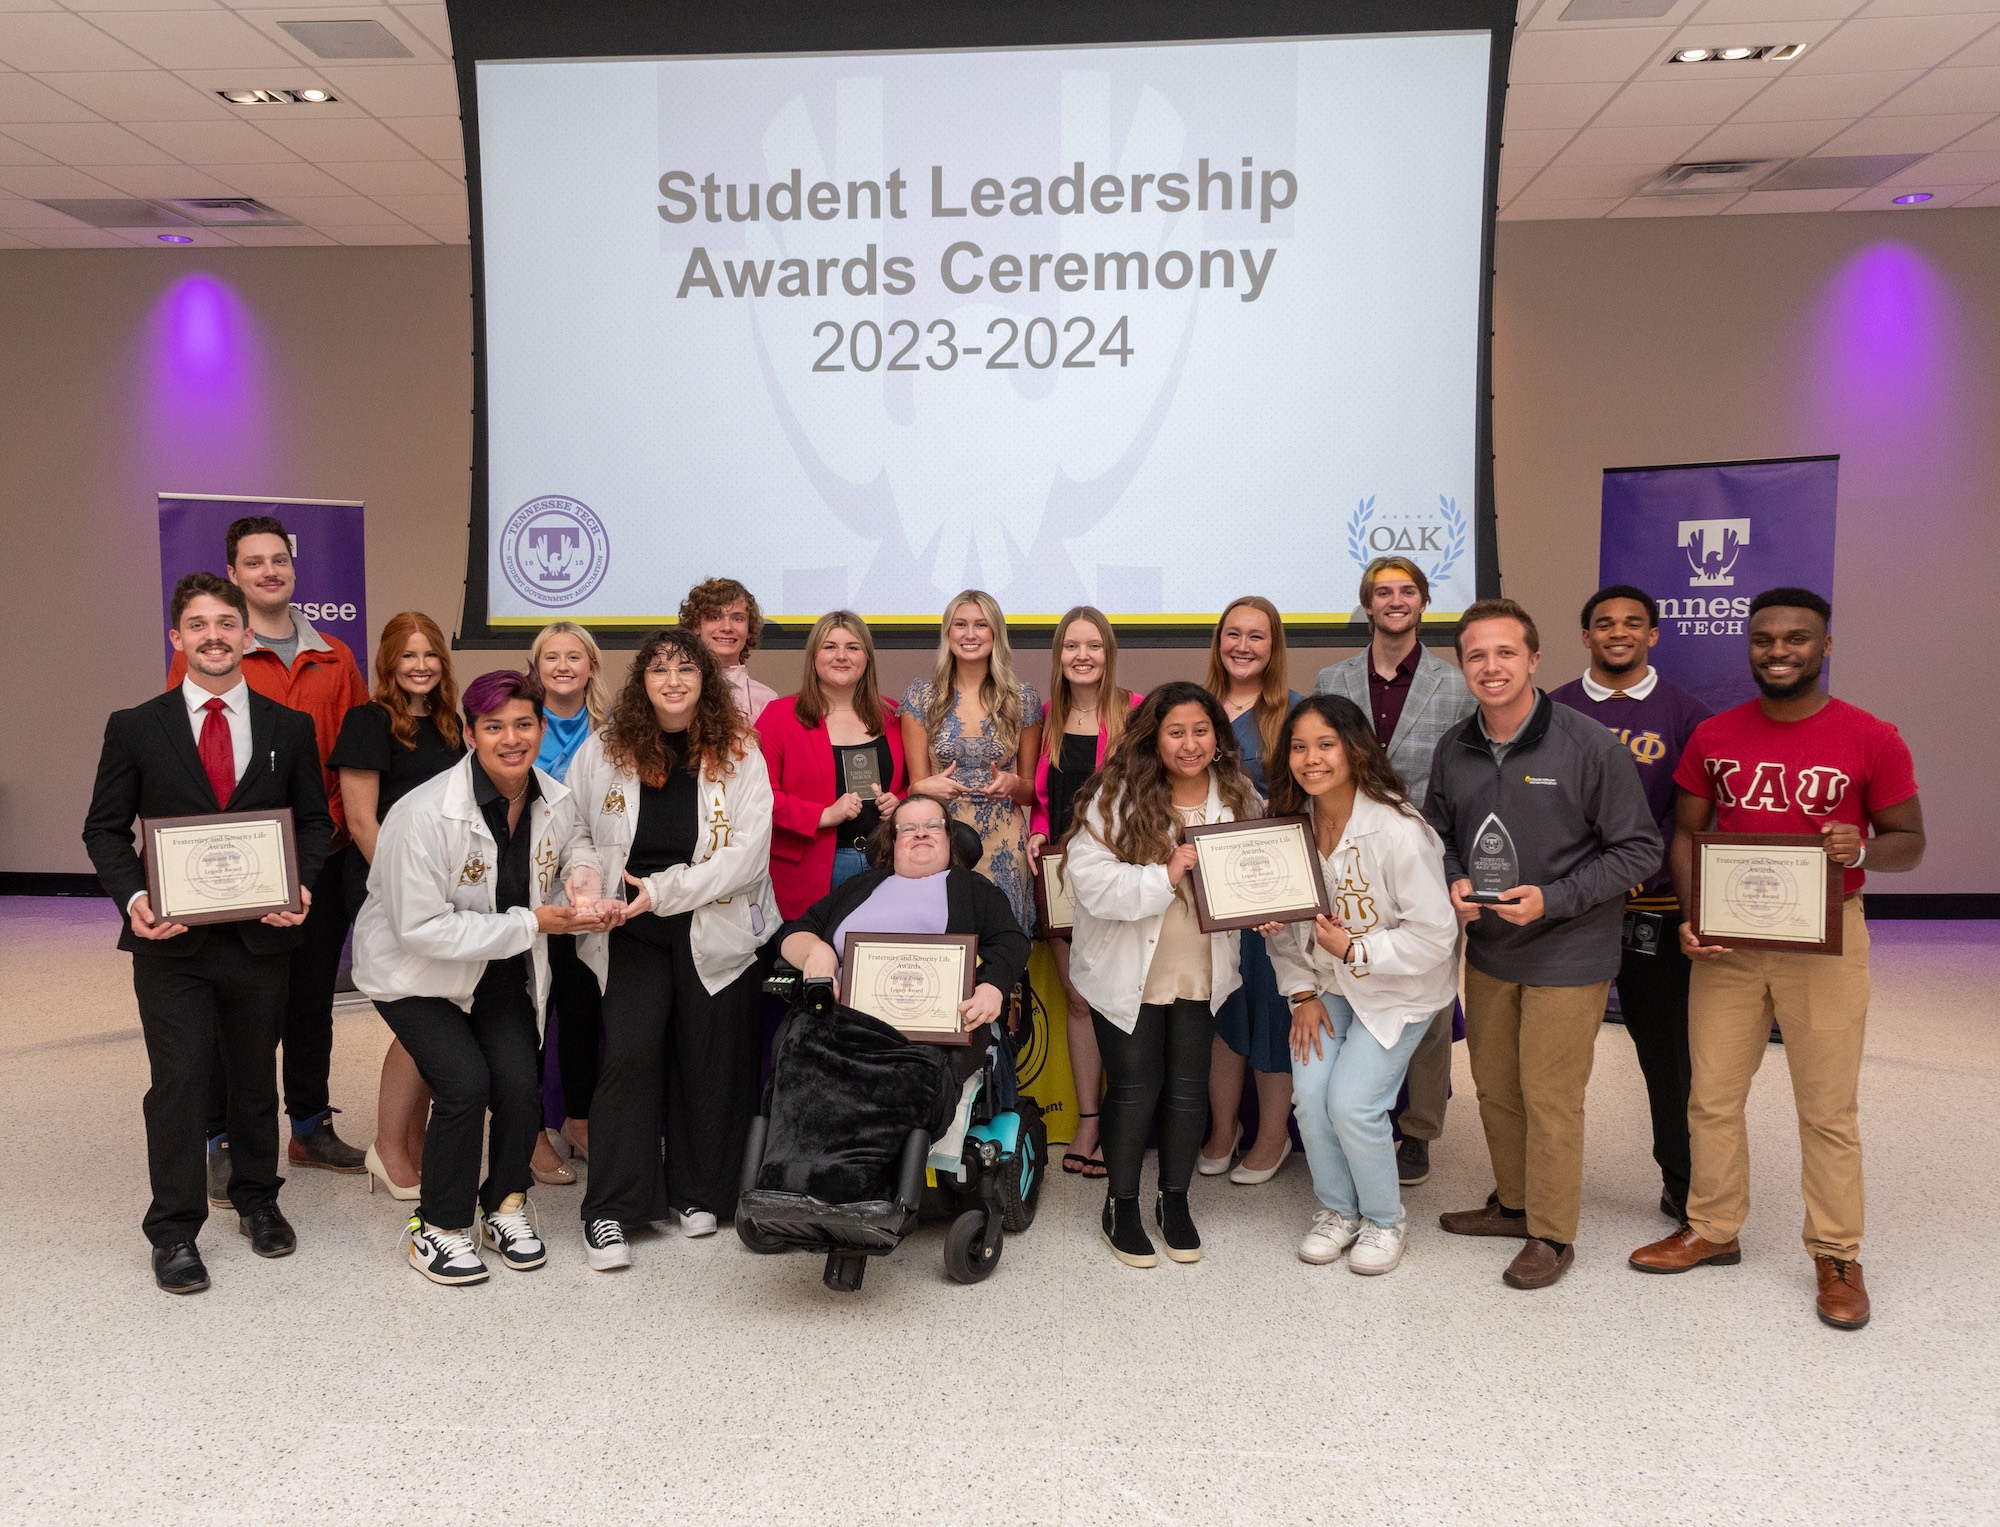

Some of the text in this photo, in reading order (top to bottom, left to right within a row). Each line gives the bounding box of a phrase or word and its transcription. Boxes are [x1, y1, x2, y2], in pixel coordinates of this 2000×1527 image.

[656, 156, 1299, 224] Student Leadership
[676, 241, 1277, 303] Awards Ceremony
[811, 315, 1134, 372] 2023-2024
[508, 500, 601, 536] TENNESSEE TECH
[506, 555, 604, 602] STUDENT GOVERNMENT ASSOCIATION
[1677, 620, 1744, 636] TECH
[172, 836, 209, 846] Fraternity
[224, 834, 252, 842] Sorority
[1210, 842, 1241, 852] Fraternity
[1254, 838, 1278, 846] Sorority
[1241, 848, 1265, 856] Awards
[1716, 856, 1750, 866] Fraternity
[1766, 858, 1794, 866] Sorority
[1761, 892, 1780, 900] Award
[868, 954, 899, 962] Fraternity
[912, 955, 938, 963] Sorority
[1044, 1101, 1063, 1114] ent
